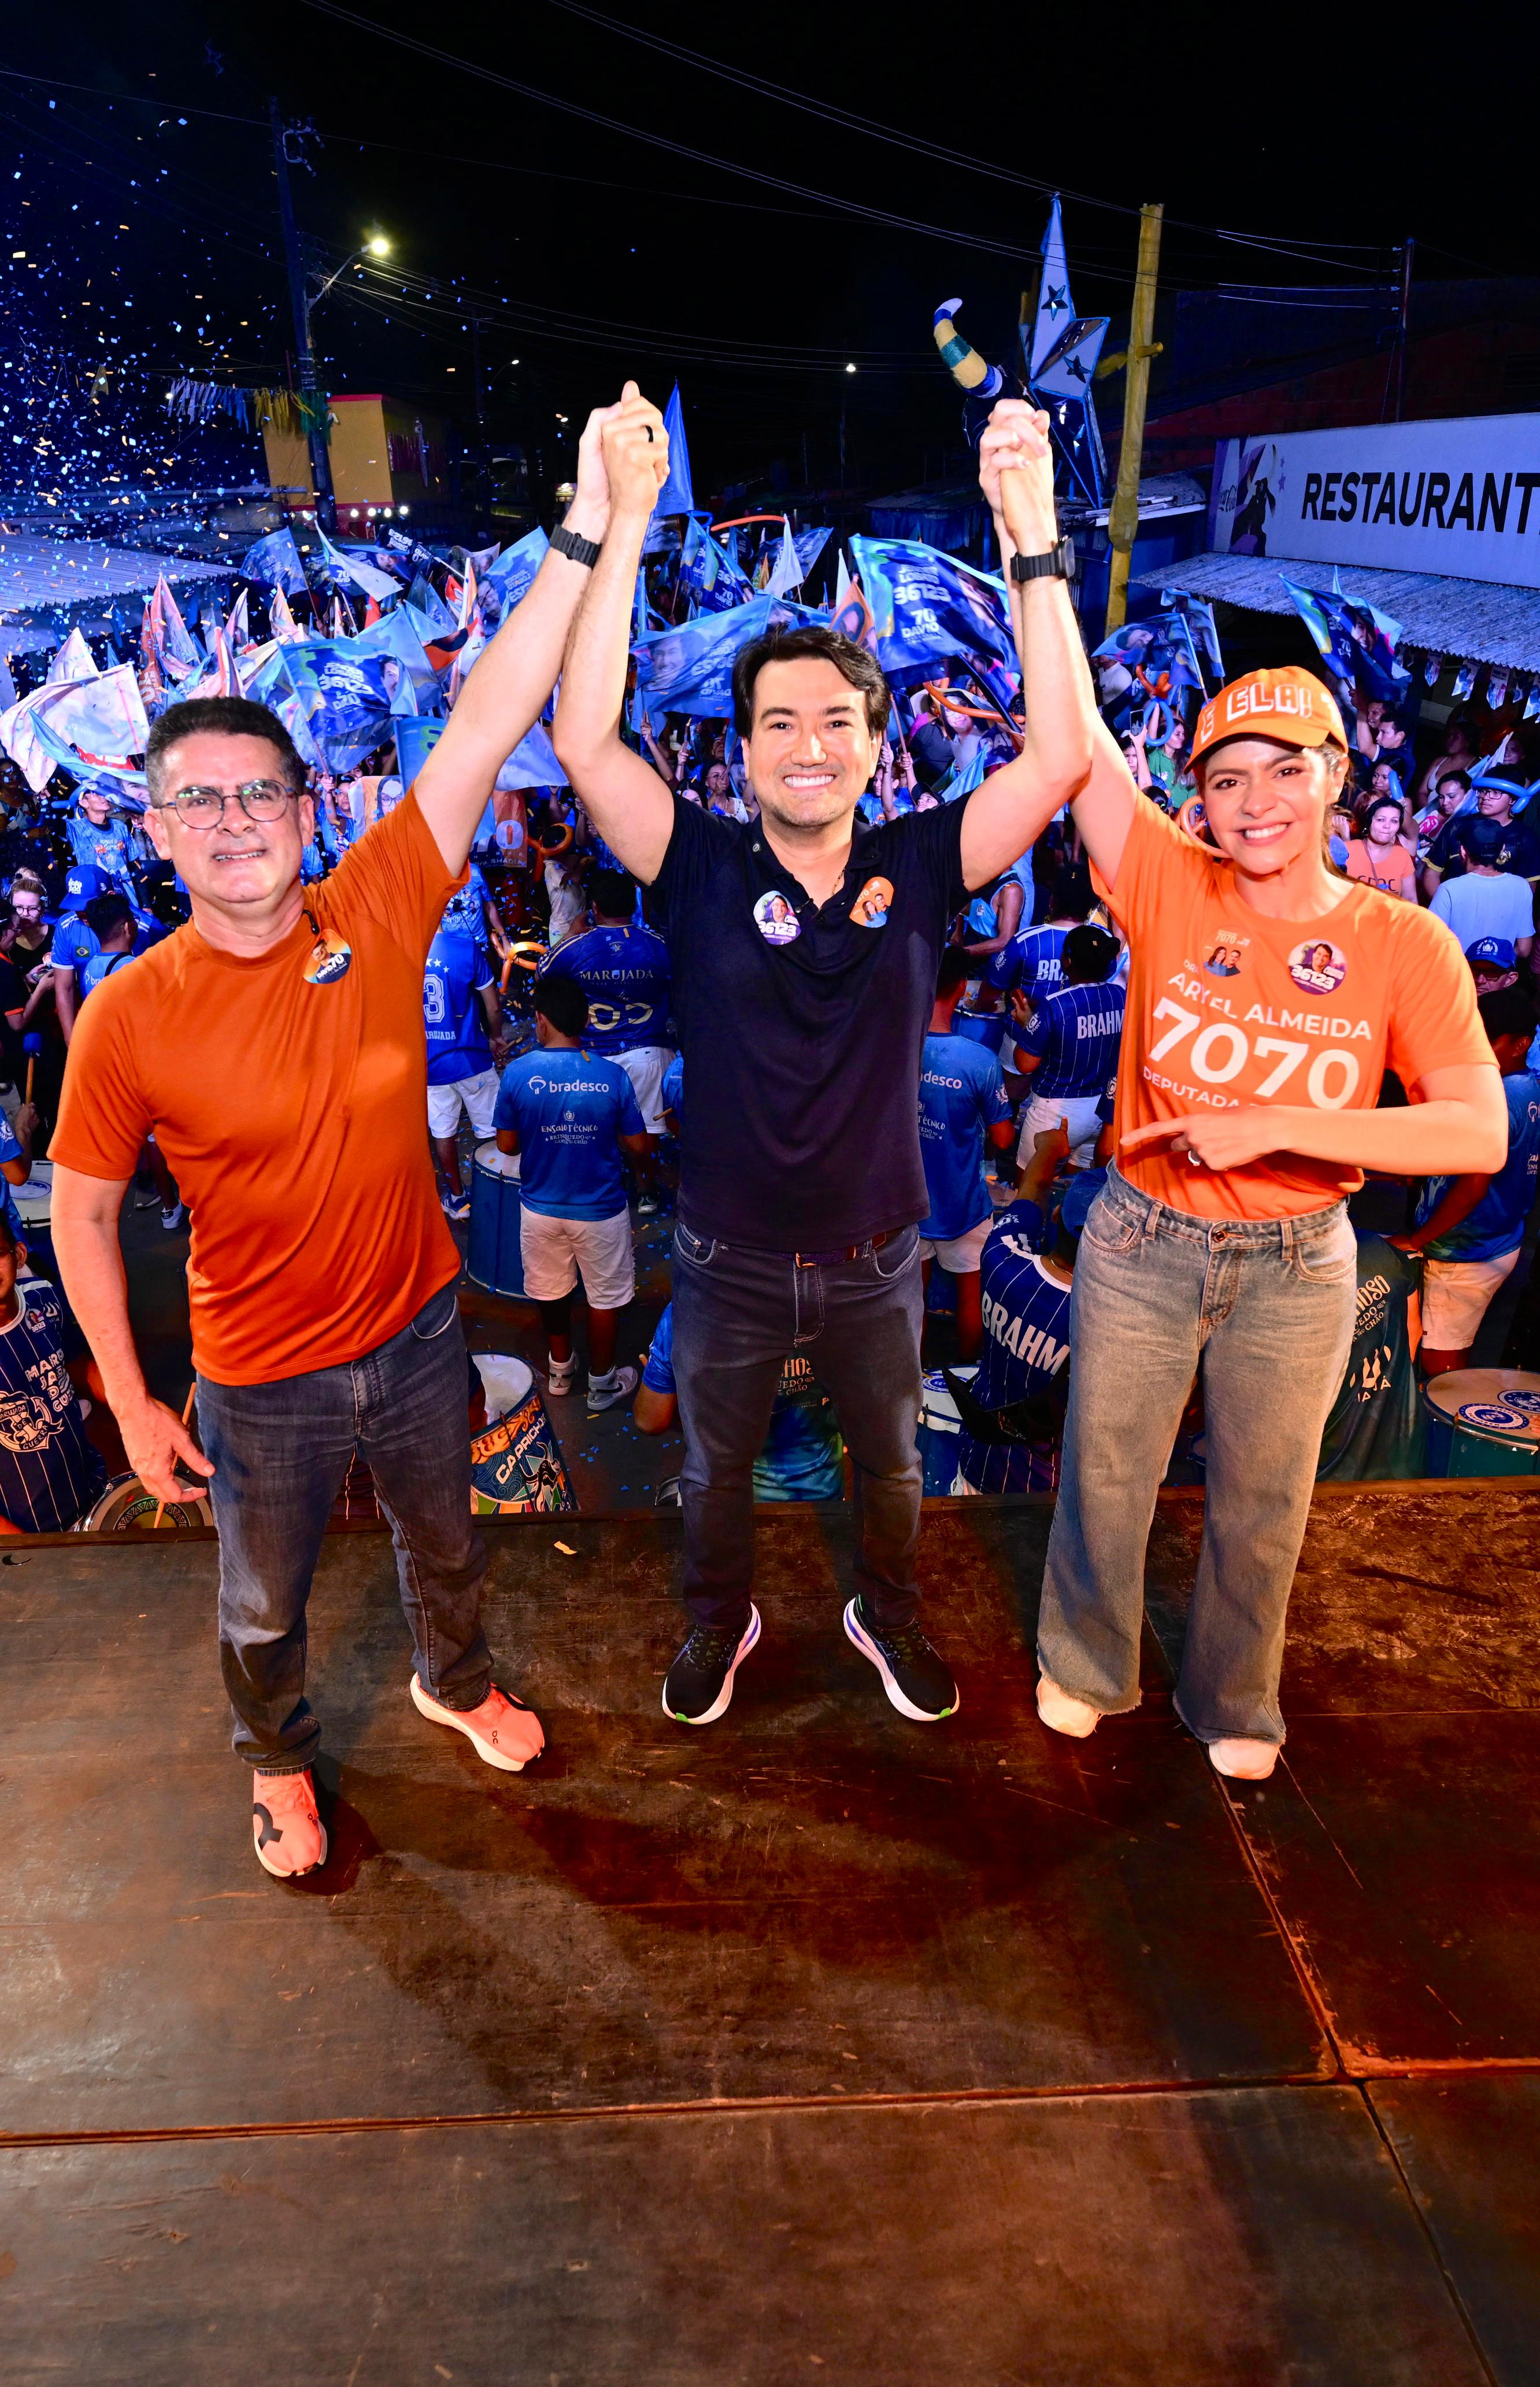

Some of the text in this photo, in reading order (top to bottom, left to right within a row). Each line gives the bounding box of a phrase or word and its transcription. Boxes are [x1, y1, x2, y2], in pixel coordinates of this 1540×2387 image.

[1301, 472, 1540, 535] RESTAURANT
[894, 583, 952, 605] 36123
[758, 921, 797, 937] 36123
[580, 970, 654, 981] MARUJADA
[1290, 964, 1336, 991] 36123
[1077, 1008, 1126, 1040] BRAHM
[1243, 1003, 1372, 1040] ALMEIDA
[426, 1031, 457, 1040] ARUJADA
[1148, 996, 1360, 1110] 7070
[549, 1078, 610, 1093] bradesco
[982, 1290, 1071, 1376] BRAHM
[1365, 1311, 1384, 1331] CHÃO
[23, 1424, 49, 1450] GUERRA
